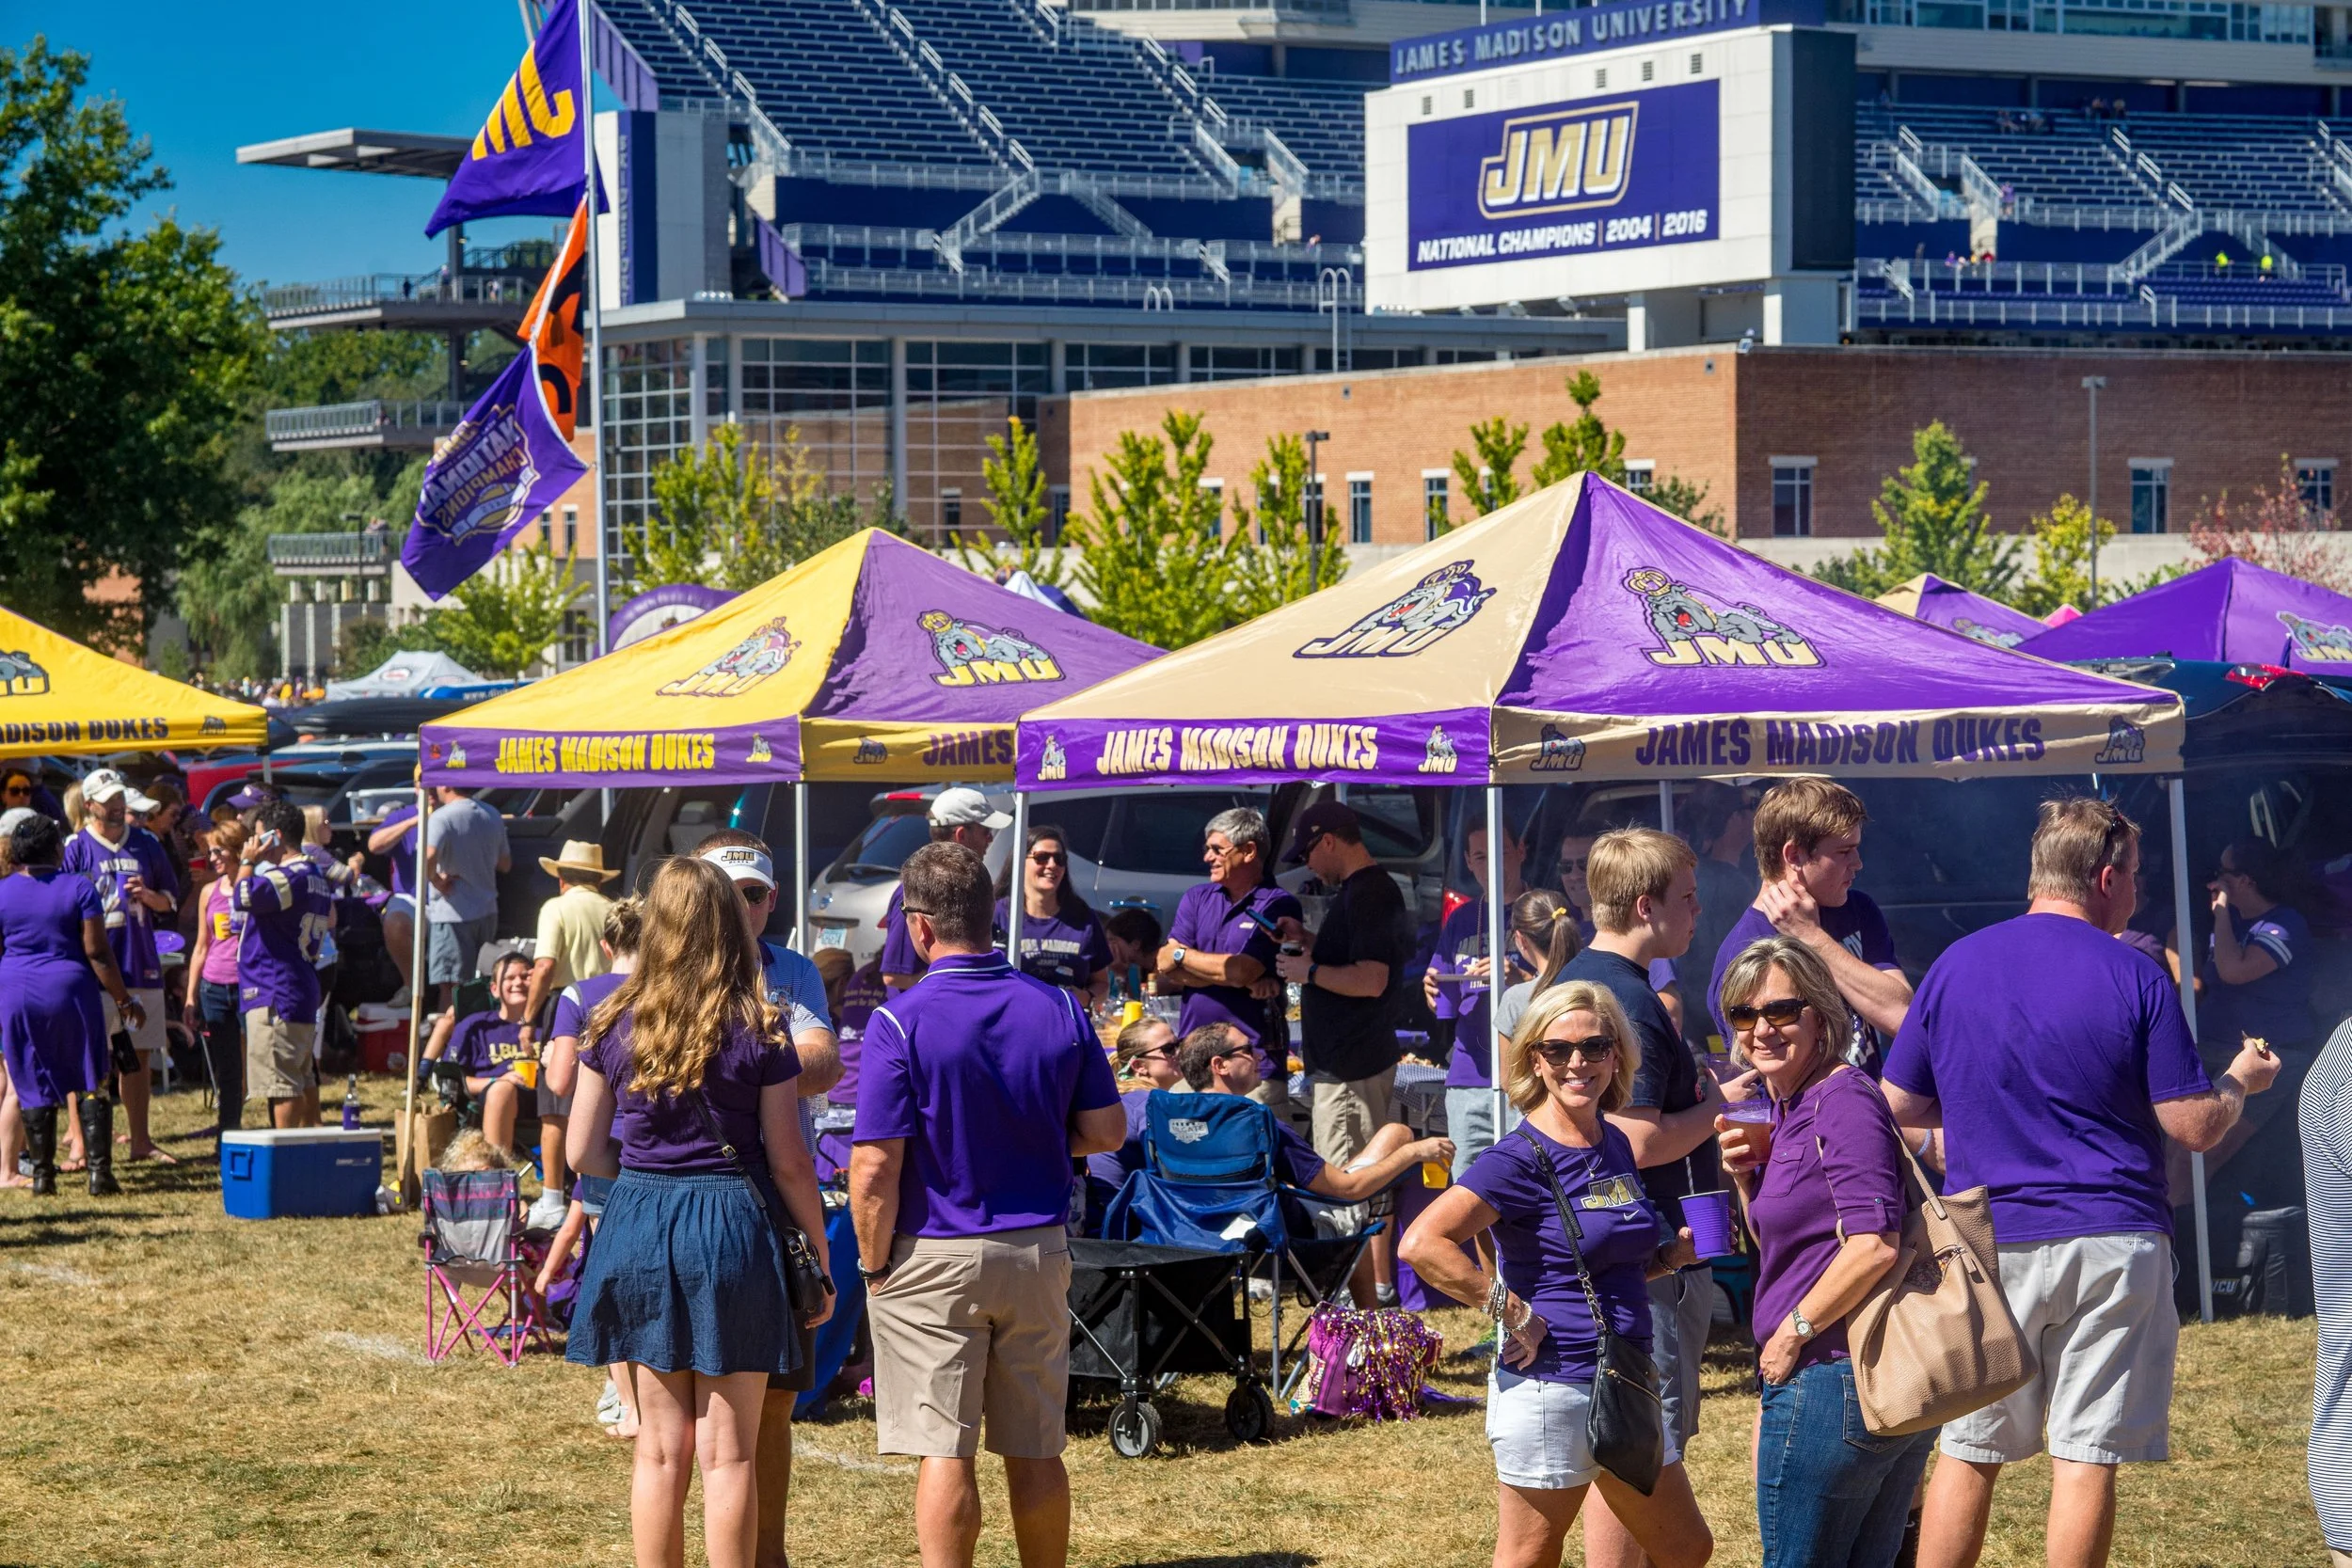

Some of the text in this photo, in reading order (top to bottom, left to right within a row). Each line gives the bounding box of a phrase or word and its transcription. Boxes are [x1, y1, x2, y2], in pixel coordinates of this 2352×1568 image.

[1396, 0, 1747, 74] JAMES MADISON UNIVERSITY
[1485, 116, 1630, 207] JMU
[1418, 209, 1708, 262] NATIONAL CHAMPIONS 2004 2016
[1302, 626, 1441, 657] JMU
[1648, 636, 1820, 666] JMU
[2296, 645, 2352, 660] JM
[935, 657, 1064, 686] JMU
[0, 718, 168, 743] DISON DUKES
[1636, 718, 2045, 765] JAMES MADISON DUKES
[495, 734, 715, 773] JAMES MADISON DUKES
[922, 729, 1014, 766] JAMES
[1096, 723, 1378, 773] JAMES MADISON DUKES
[1534, 752, 1582, 770] JMU
[2096, 750, 2145, 763] JMU
[1038, 767, 1067, 781] JMU
[1418, 756, 1459, 773] JMU
[721, 851, 755, 862] JMU
